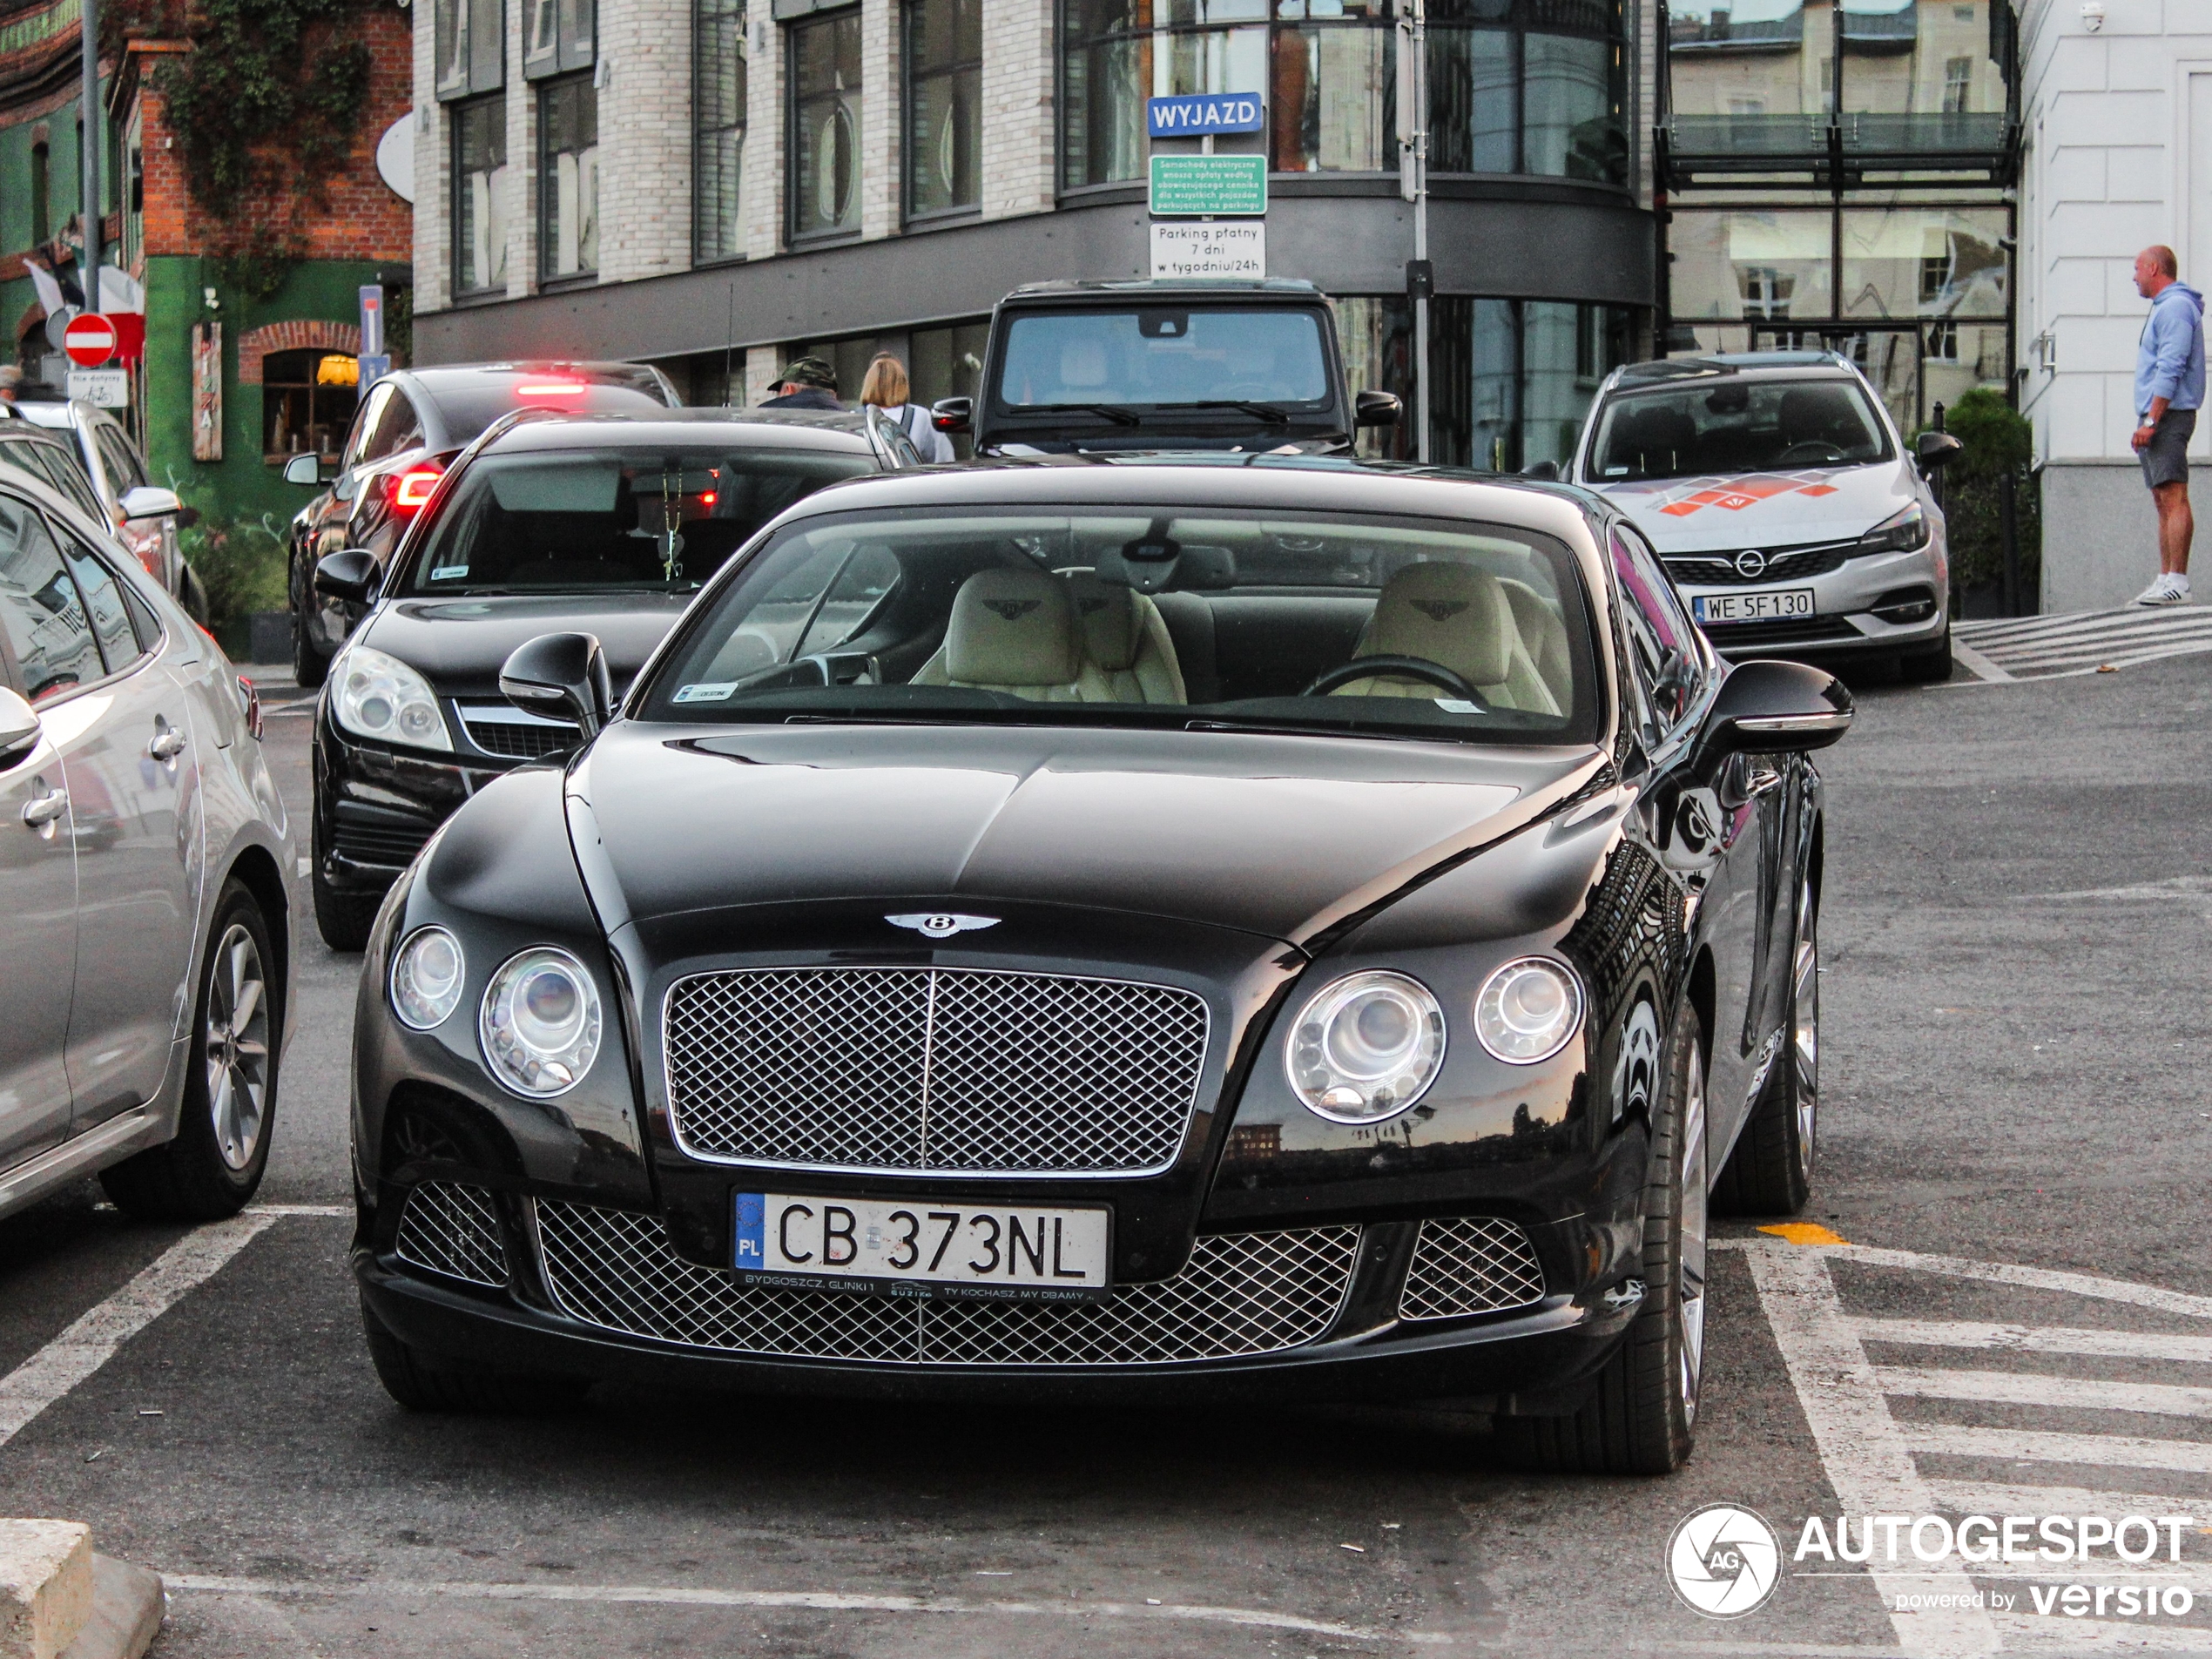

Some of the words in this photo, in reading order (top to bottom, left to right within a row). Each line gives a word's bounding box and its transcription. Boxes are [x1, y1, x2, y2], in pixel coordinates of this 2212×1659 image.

[1153, 101, 1256, 128] WYJAZD
[1160, 160, 1208, 170] Samochody
[1211, 161, 1257, 170] elektryczne
[1175, 192, 1217, 200] wszystkich
[1223, 202, 1260, 211] parkingu
[1159, 227, 1209, 241] Parking
[1216, 227, 1258, 241] płatny
[1191, 244, 1198, 255] 7
[1204, 244, 1225, 255] dni
[1172, 260, 1259, 274] tygodniu/24h
[200, 339, 214, 429] PIZZA
[1709, 598, 1736, 618] WE
[1744, 595, 1808, 617] 5F130
[739, 1238, 760, 1257] PL
[779, 1204, 859, 1266] CB
[887, 1210, 1087, 1278] 373NL
[828, 1280, 867, 1291] GLINKI
[944, 1287, 959, 1296] TY
[1041, 1291, 1084, 1299] DBAMY
